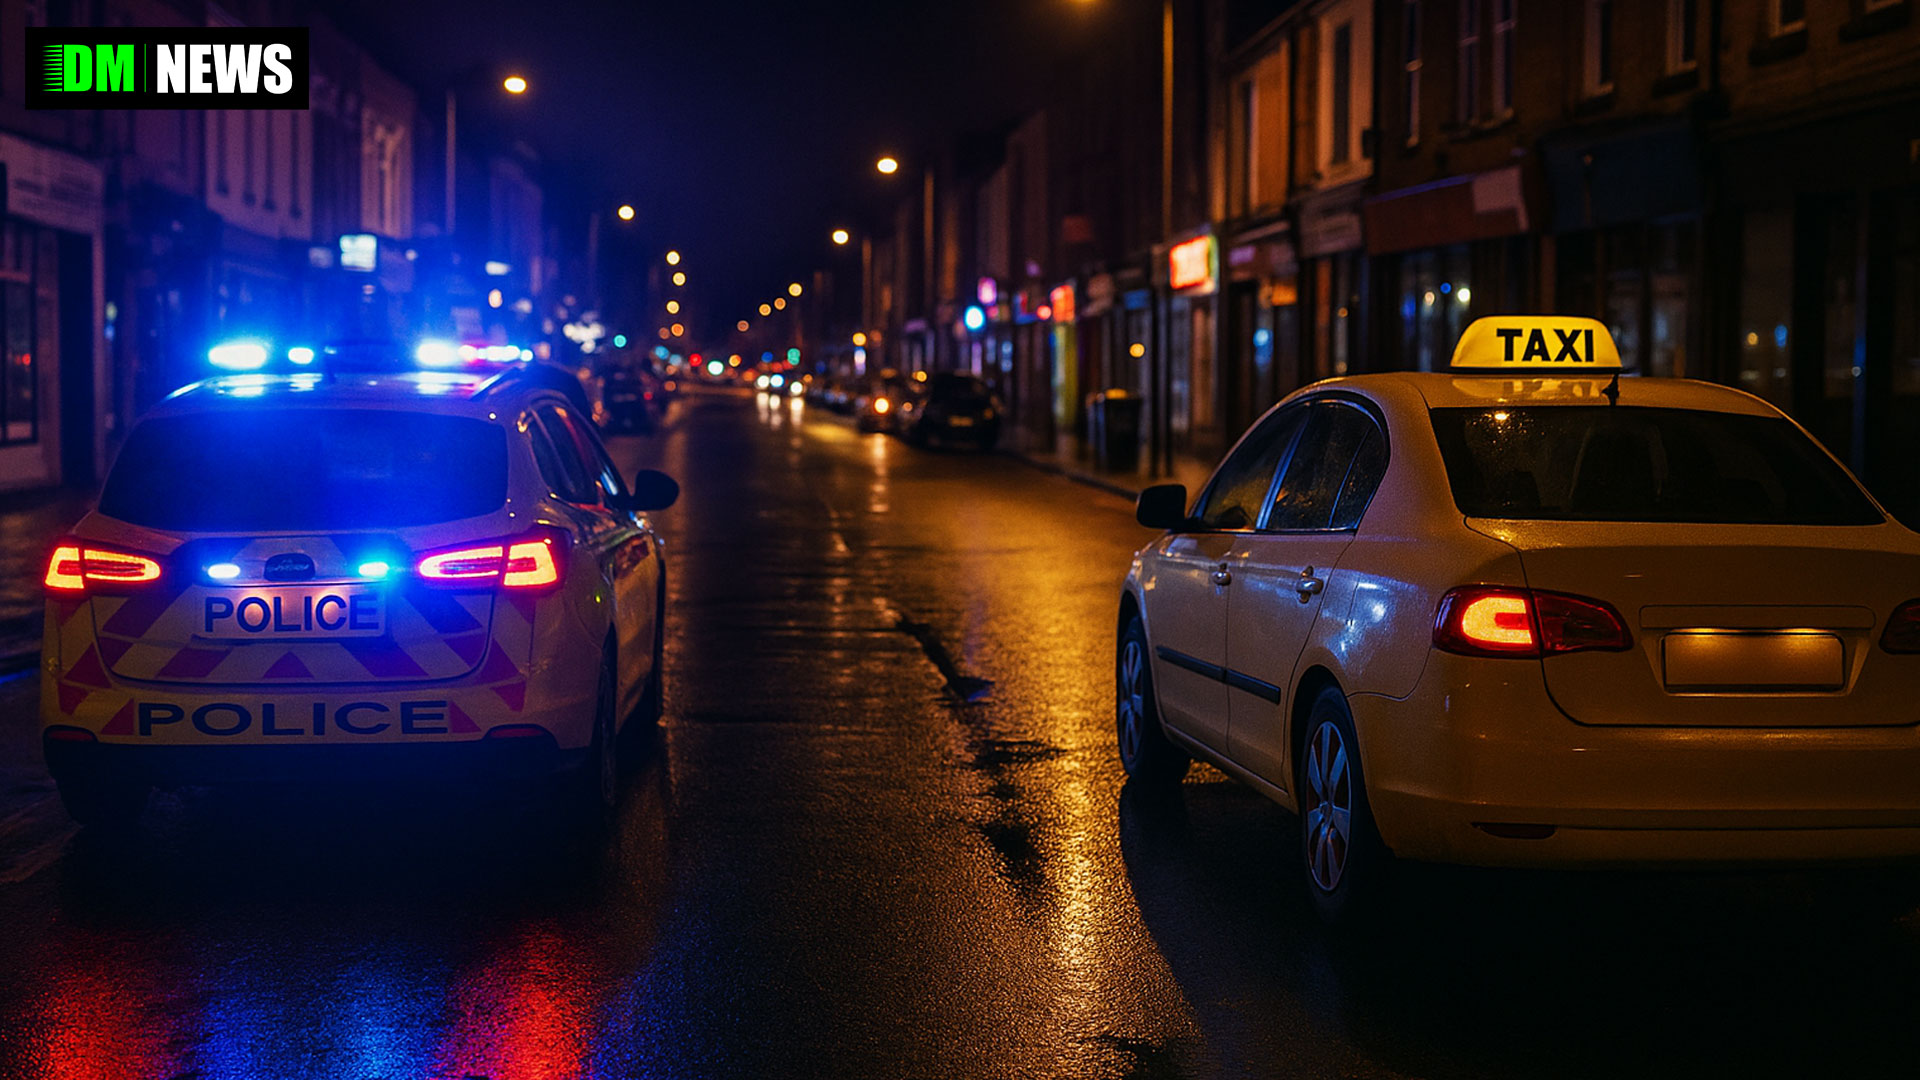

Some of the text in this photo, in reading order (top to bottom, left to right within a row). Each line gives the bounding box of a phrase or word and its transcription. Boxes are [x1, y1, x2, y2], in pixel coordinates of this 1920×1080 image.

[1496, 328, 1595, 363] TAXI
[204, 593, 380, 634] POLICE
[137, 699, 449, 737] POLICE
